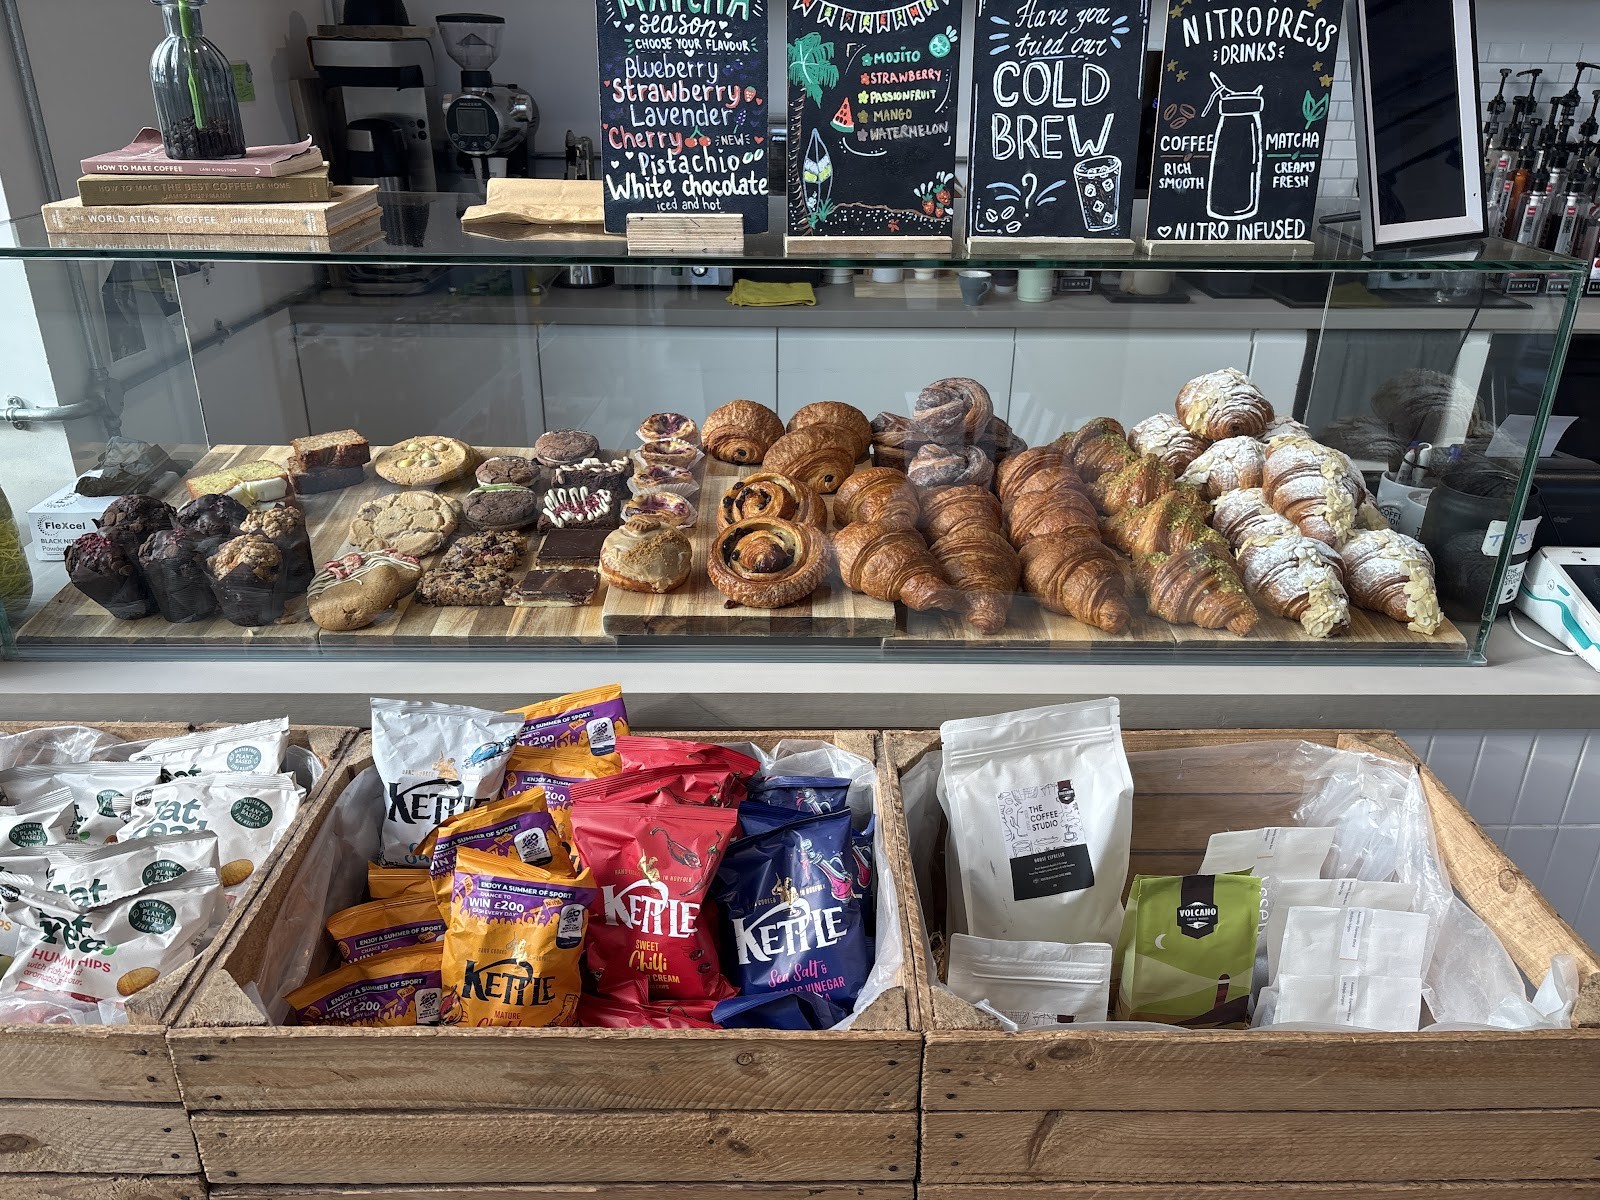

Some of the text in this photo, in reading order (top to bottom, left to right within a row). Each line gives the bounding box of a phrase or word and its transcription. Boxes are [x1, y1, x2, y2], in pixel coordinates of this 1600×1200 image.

[1014, 0, 1111, 34] Have you
[639, 13, 717, 38] season
[1182, 7, 1337, 52] NITROPRESS
[635, 37, 751, 52] CHOOSE YOUR FLAVOUR
[1015, 32, 1108, 56] tried our
[873, 47, 921, 64] MOJITO
[1221, 41, 1276, 65] DRINKS
[625, 53, 718, 83] Blueberry
[870, 69, 942, 84] STRAWBERRY
[992, 60, 1111, 108] COLD
[612, 77, 741, 109] Strawberry
[870, 89, 937, 105] PASSIONFRUIT
[629, 103, 733, 127] Lavender
[873, 108, 912, 123] MANGO
[870, 121, 949, 141] WATERMELON
[991, 113, 1115, 160] BREW
[608, 126, 683, 155] Cherry
[720, 135, 745, 146] NEW
[1160, 134, 1214, 152] COFFEE
[1265, 132, 1320, 150] MATCHA
[638, 145, 740, 176] Pistachio
[1274, 161, 1315, 174] CREAMY
[1164, 163, 1192, 175] RICH
[135, 184, 158, 192] MAKE
[161, 183, 182, 191] THE
[185, 183, 209, 191] BEST
[213, 182, 253, 191] COFFEE
[605, 170, 769, 201] White chocolate
[1158, 177, 1205, 190] SMOOTH
[1272, 175, 1309, 189] FRESH
[656, 198, 722, 211] iced and hot
[88, 214, 125, 223] WORLD
[129, 214, 160, 224] ATLAS
[176, 215, 217, 224] COFFEE
[229, 216, 252, 224] JAMES
[1175, 219, 1306, 240] NITRO INFUSED
[45, 522, 86, 530] FleXcel
[1489, 533, 1529, 547] TPS
[536, 719, 562, 729] SUMMER
[571, 711, 591, 720] SPORT
[545, 790, 566, 802] 200
[243, 799, 270, 813] GLUTEN FREE
[243, 804, 264, 816] PLANT
[1028, 804, 1043, 814] THE
[240, 809, 260, 821] BASED
[1030, 810, 1059, 822] COFFEE
[1031, 819, 1059, 832] STUDIO
[457, 833, 485, 844] SUMMER
[496, 823, 518, 836] SPORT
[430, 867, 446, 876] CASH
[669, 875, 693, 883] NORFOLK
[480, 891, 503, 899] CHANCE
[481, 881, 502, 889] ENJOY
[509, 886, 538, 896] SUMMER
[549, 891, 573, 899] SPORT
[139, 901, 171, 914] GLUTEN FREE
[469, 897, 525, 913] WIN £200
[601, 879, 700, 938] KETTLE
[1179, 907, 1217, 918] VOLCANO
[142, 909, 165, 919] PLANT
[142, 915, 164, 925] BASED
[360, 938, 378, 946] ENJOY
[384, 930, 411, 940] SUMMER
[731, 898, 847, 965] KETTLE
[361, 946, 381, 954] CHANCE
[635, 939, 659, 952] SWEET
[27, 961, 47, 971] with
[628, 949, 668, 973] Chilli
[652, 974, 681, 984] CREAM
[768, 960, 828, 988] Sea Salt &
[461, 958, 556, 1007] KETTLE
[805, 976, 846, 994] VINEGAR
[330, 990, 353, 1006] ENJOY
[361, 984, 389, 993] SUMMER
[401, 978, 423, 987] SPORT
[353, 1001, 380, 1014] £200
[494, 1010, 521, 1020] MATURE
